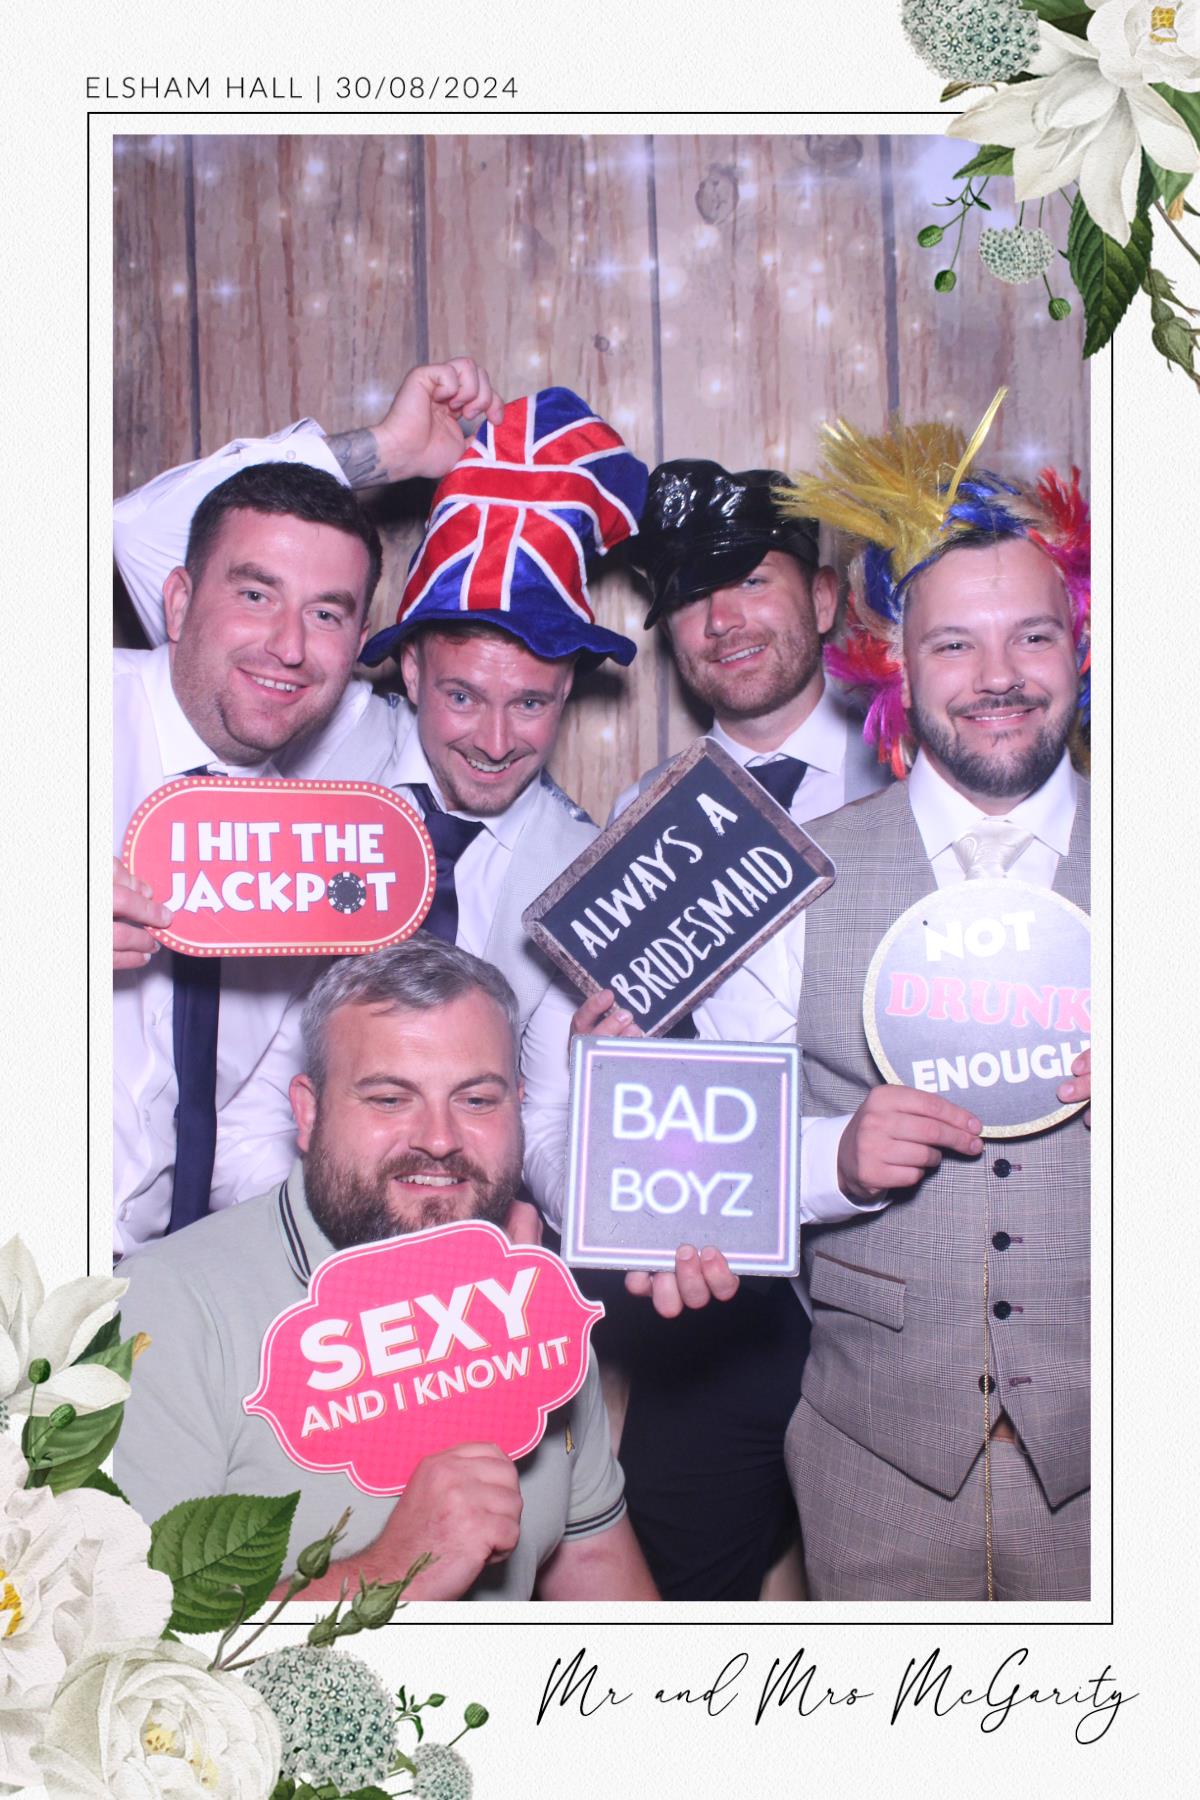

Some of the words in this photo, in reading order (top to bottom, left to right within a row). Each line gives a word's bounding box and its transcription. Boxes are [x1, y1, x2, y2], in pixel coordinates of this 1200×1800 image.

[170, 822, 185, 862] I
[198, 821, 280, 862] HIT
[292, 823, 384, 864] THE
[570, 825, 703, 959] ALWAYS
[696, 793, 739, 836] A
[611, 846, 793, 1015] BRIDESMAID
[925, 911, 1036, 962] NOT
[885, 972, 1091, 1033] DRUNK
[612, 1082, 758, 1144] BAD
[610, 1167, 753, 1217] BOYZ
[299, 1266, 541, 1392] SEXY
[300, 1389, 388, 1439] AND
[393, 1382, 408, 1412] I
[413, 1346, 530, 1406] KNOW
[538, 1336, 570, 1370] IT
